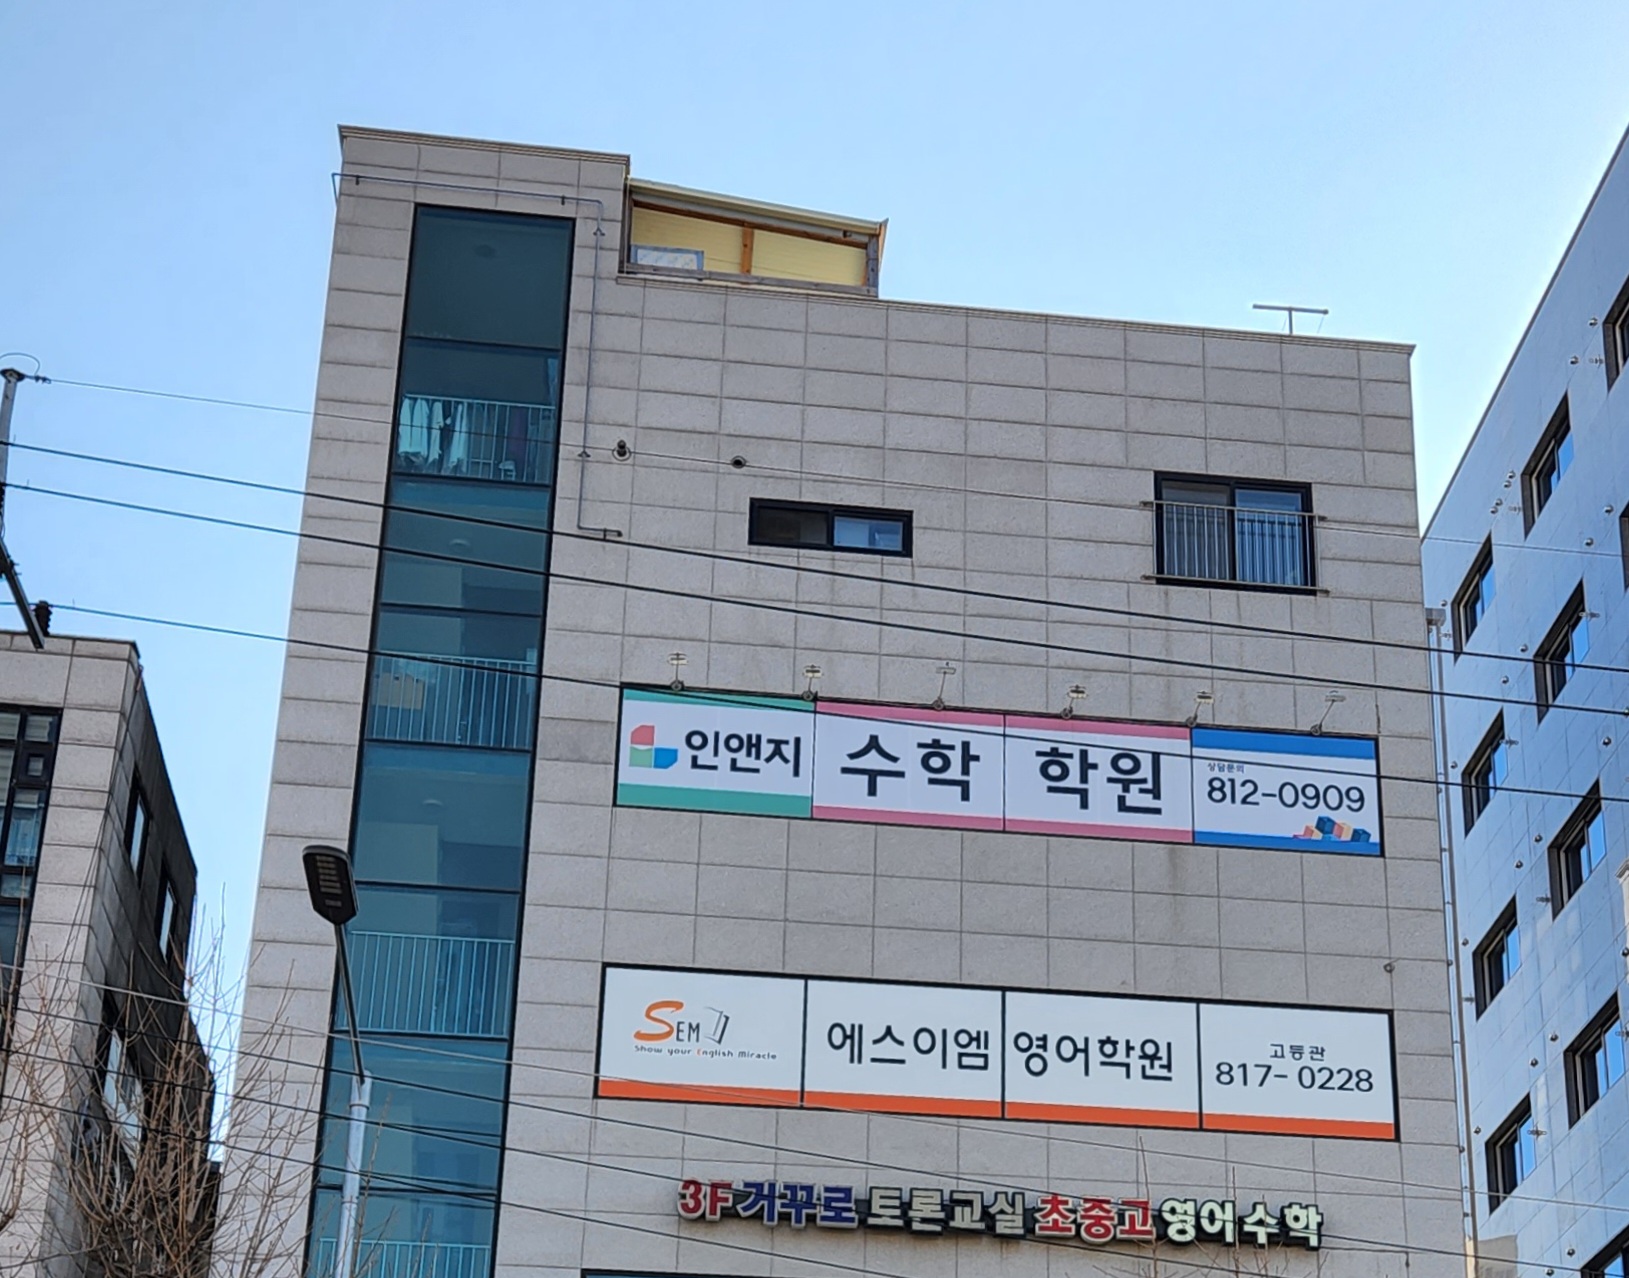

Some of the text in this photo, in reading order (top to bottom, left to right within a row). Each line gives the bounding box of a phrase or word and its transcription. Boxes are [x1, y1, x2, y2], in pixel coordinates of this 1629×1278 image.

[685, 729, 1163, 816] 인앤지 수학 학원
[1207, 776, 1365, 813] 812-0909
[633, 1000, 701, 1043] SEM
[635, 1044, 663, 1054] Show
[667, 1046, 692, 1057] your
[697, 1048, 734, 1059] English
[827, 1020, 1175, 1083] 에스이엠 영어학원
[1269, 1043, 1326, 1062] 고등관
[679, 1178, 733, 1220] 3F
[736, 1179, 860, 1229] 거꾸로
[865, 1185, 1027, 1238] 토론교실
[1035, 1192, 1155, 1244] 초중고
